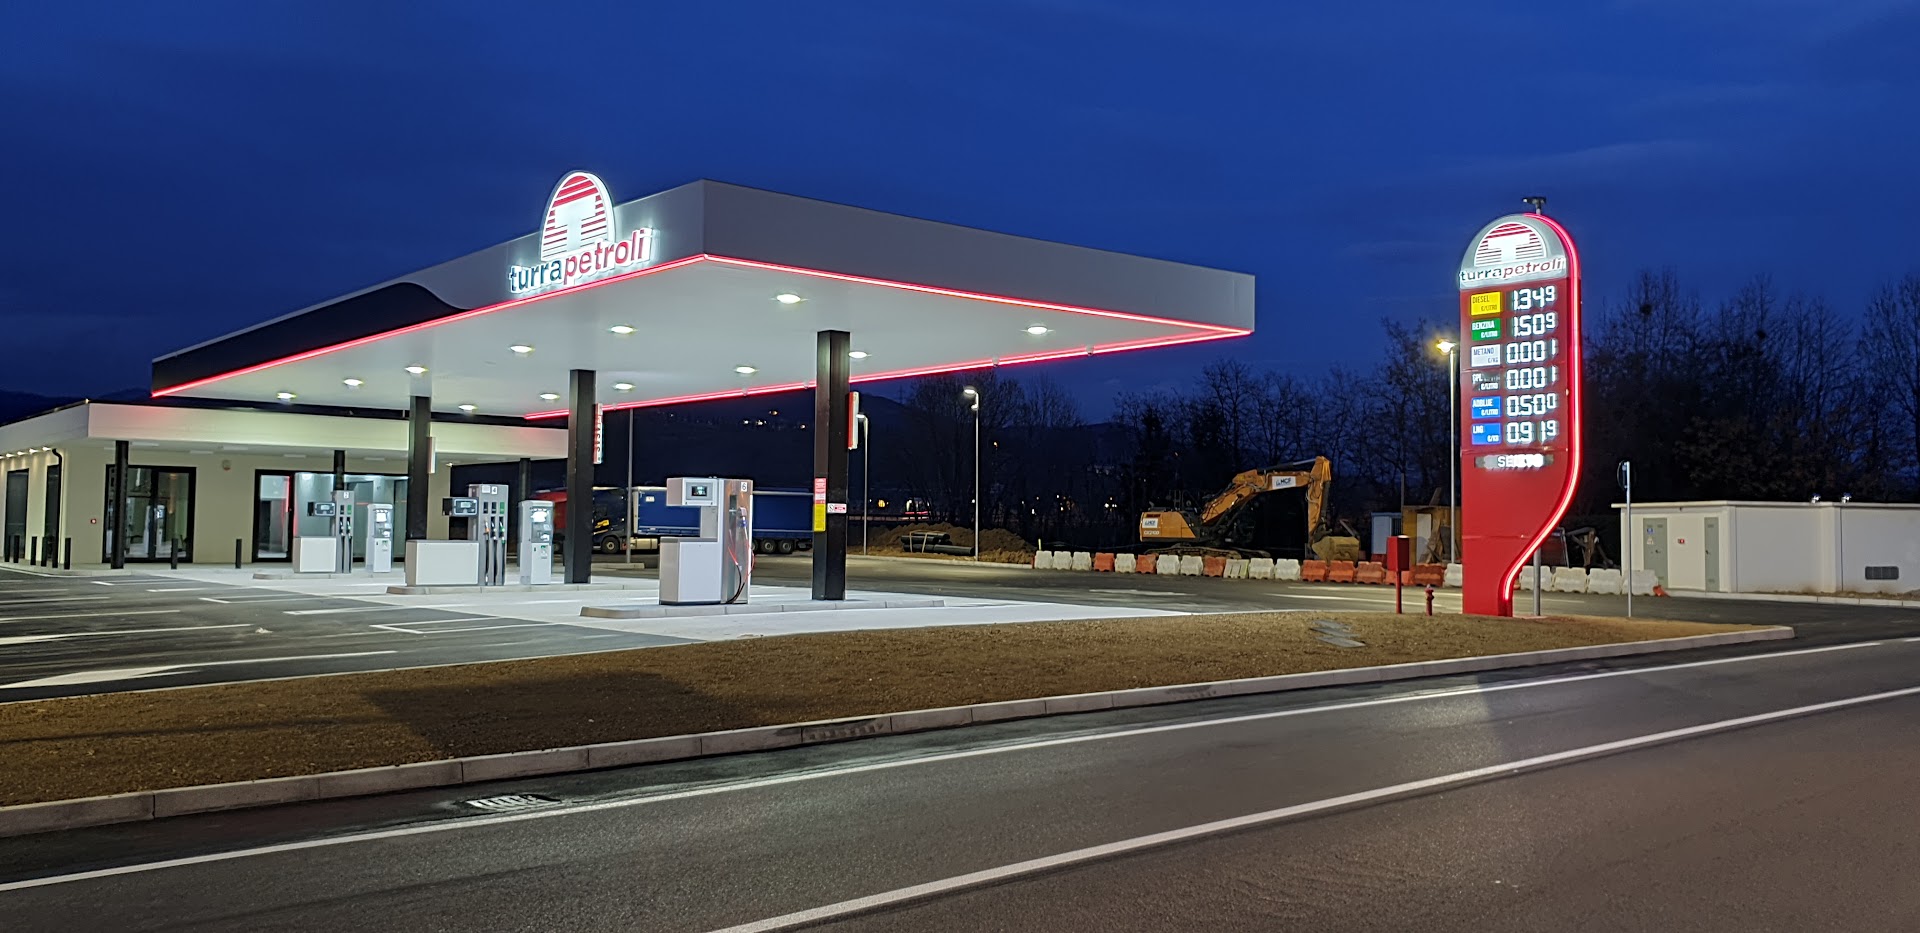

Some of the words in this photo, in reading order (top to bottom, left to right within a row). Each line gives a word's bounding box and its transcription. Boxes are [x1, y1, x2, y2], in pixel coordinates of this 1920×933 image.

[509, 229, 647, 292] turrapetroli
[1460, 258, 1562, 281] turrapetroli
[1473, 295, 1490, 303] DIESEL
[1473, 347, 1494, 356] METANO
[742, 482, 747, 490] 6
